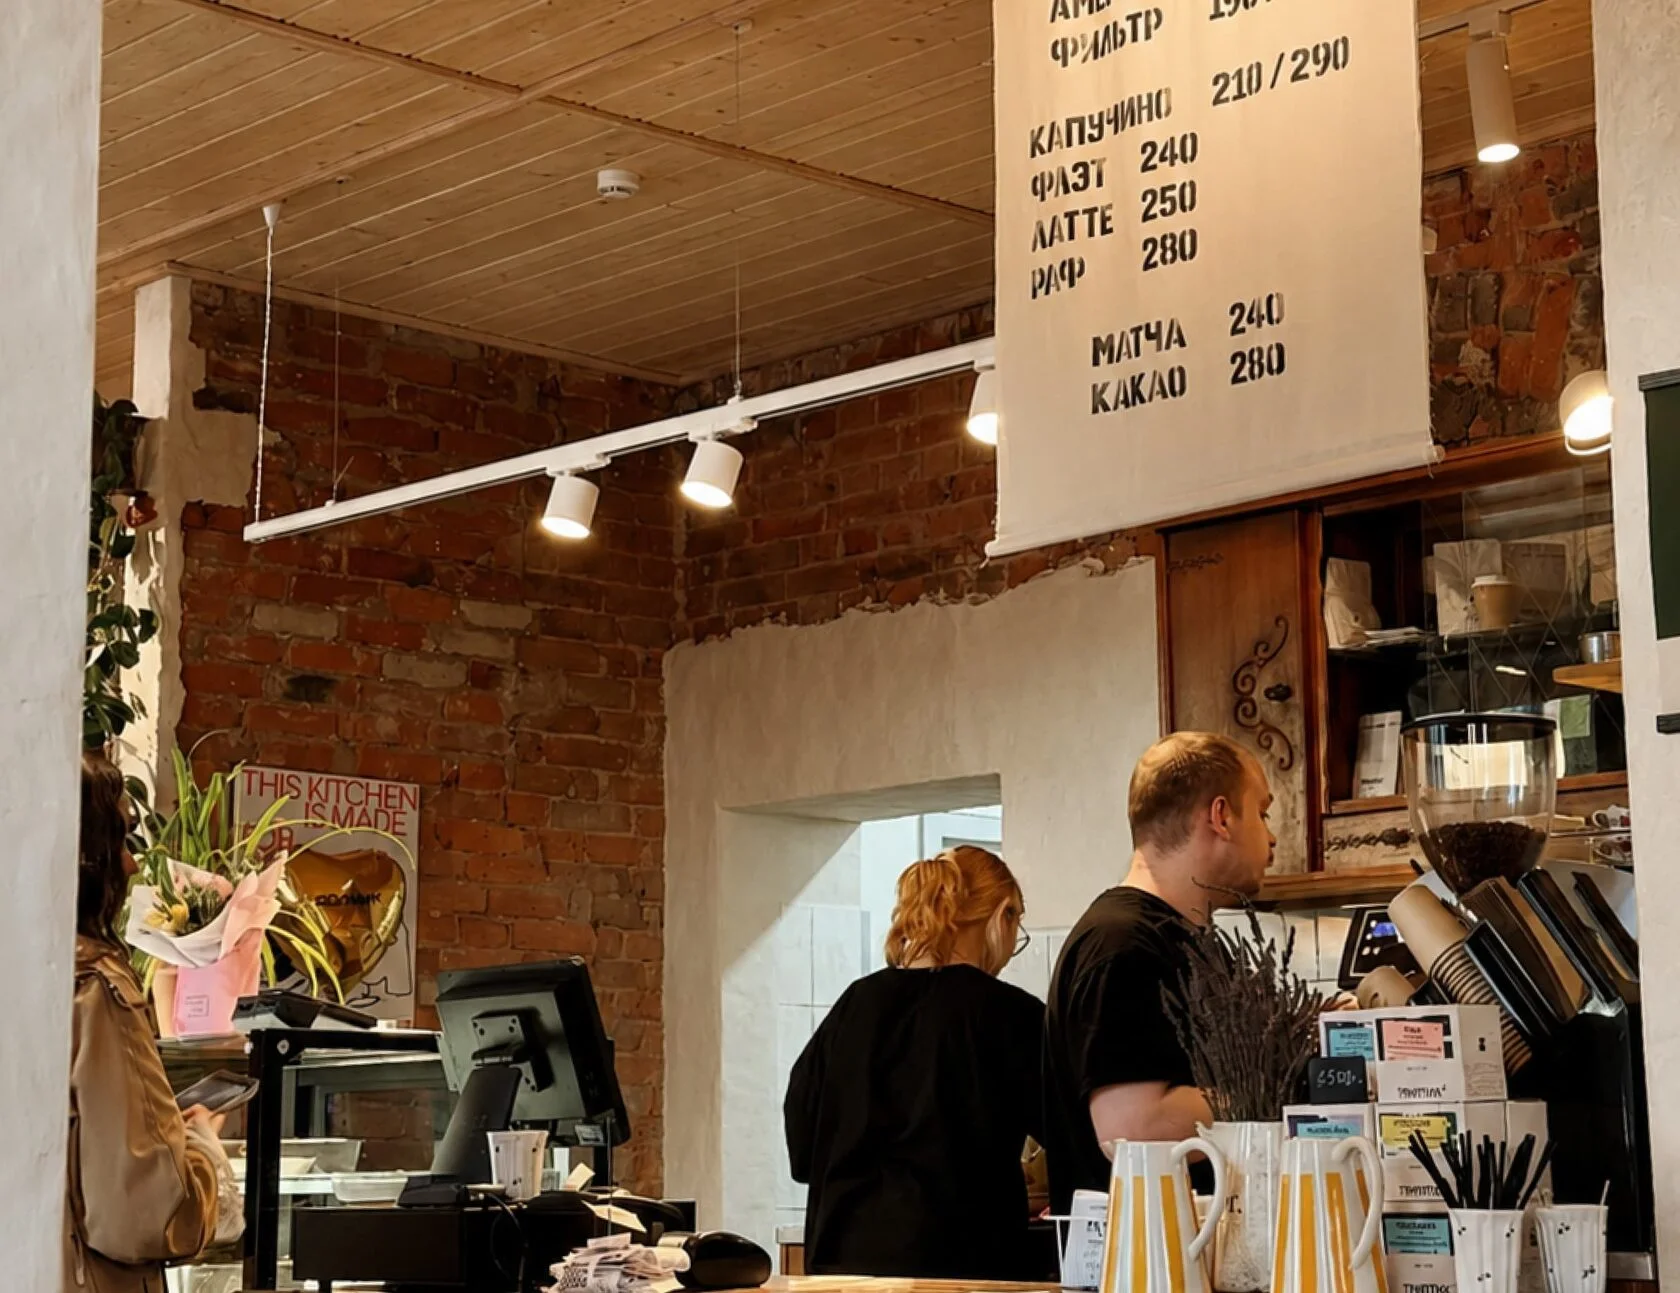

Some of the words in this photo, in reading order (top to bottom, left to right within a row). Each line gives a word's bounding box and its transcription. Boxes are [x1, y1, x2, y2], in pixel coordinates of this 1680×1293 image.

[1051, 7, 1163, 68] ФИЛЬТР
[1030, 87, 1172, 158] КАПУЧИНО
[1212, 61, 1262, 107] 210
[1290, 36, 1349, 83] 290
[1031, 157, 1106, 202] ФЛЭТ
[1140, 132, 1198, 173] 240
[1032, 203, 1114, 252] ЛАТТЕ
[1141, 180, 1196, 223] 250
[1031, 257, 1085, 300] РАФ
[1142, 228, 1197, 272] 280
[1092, 318, 1187, 367] МАТЧА
[1229, 292, 1284, 336] 240
[1091, 365, 1186, 415] КАКАО
[1230, 342, 1285, 385] 280
[243, 769, 301, 800] THIS
[308, 777, 417, 811] KITCHEN
[304, 802, 326, 828] IS
[332, 803, 407, 836] MADE
